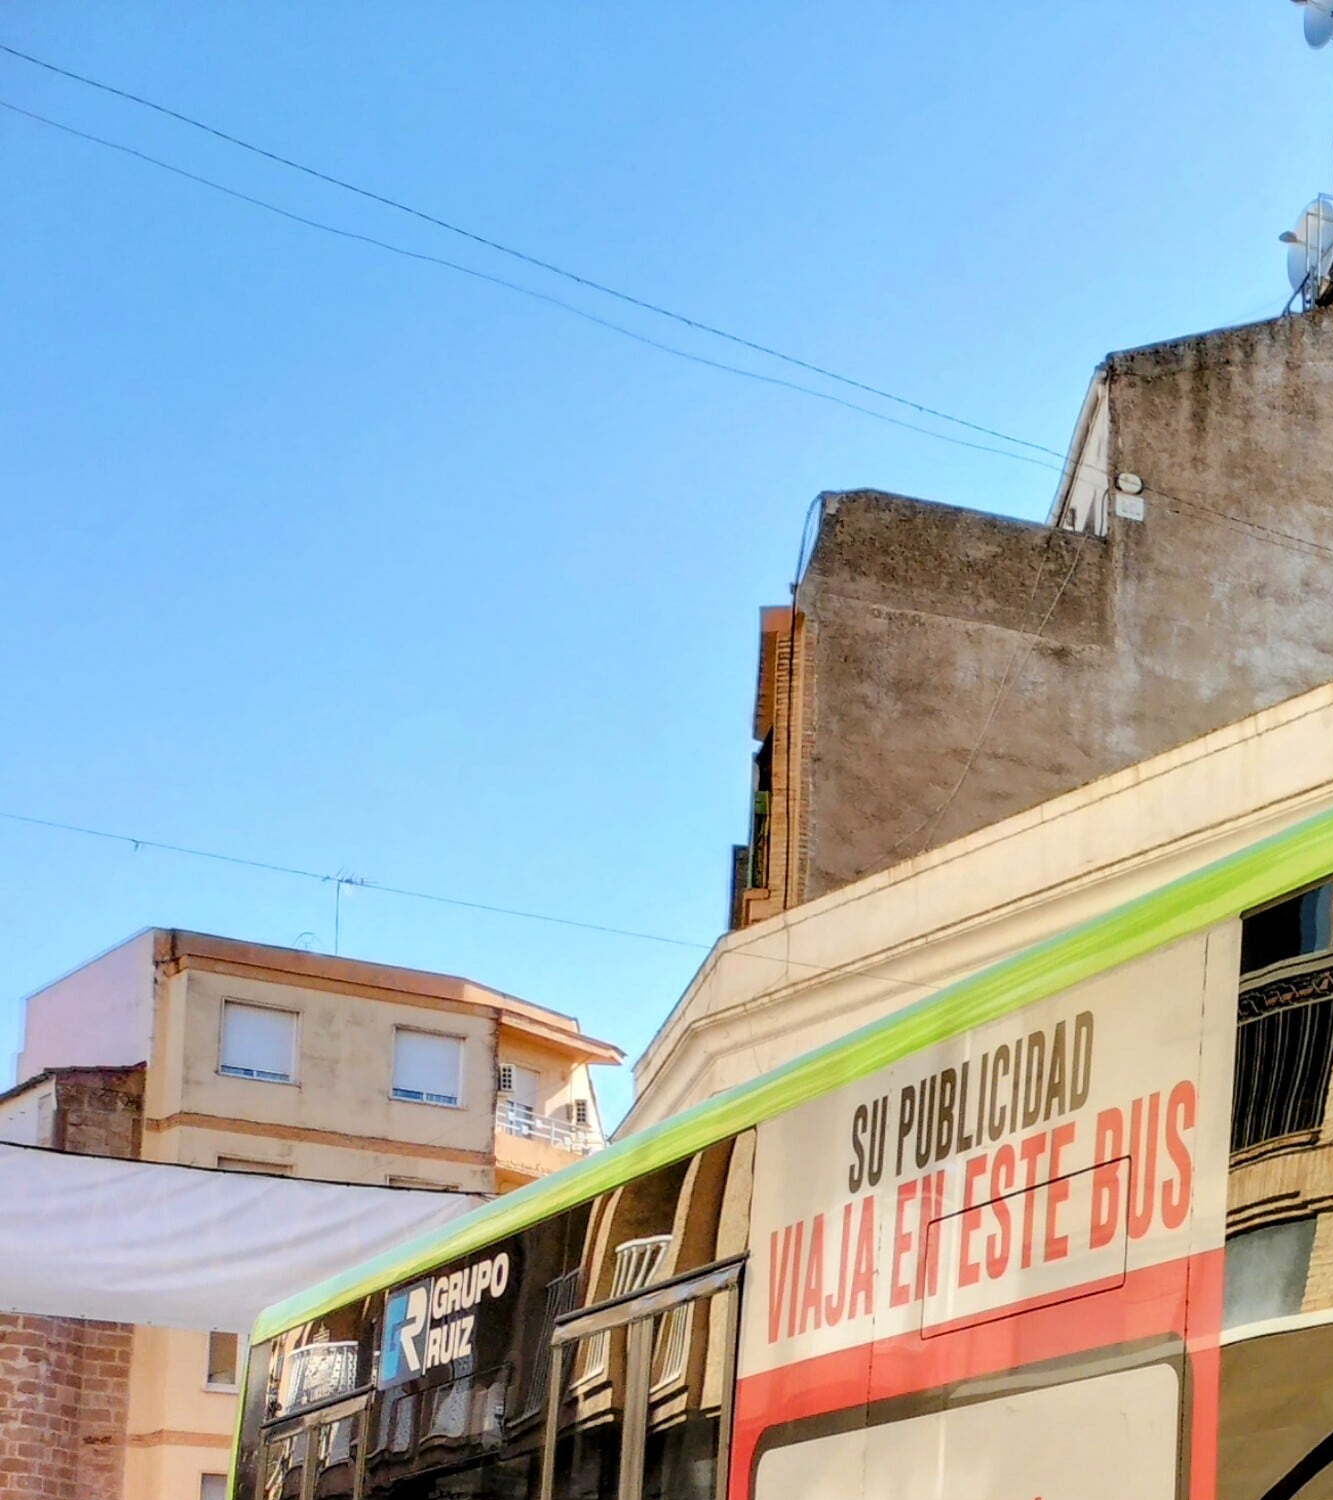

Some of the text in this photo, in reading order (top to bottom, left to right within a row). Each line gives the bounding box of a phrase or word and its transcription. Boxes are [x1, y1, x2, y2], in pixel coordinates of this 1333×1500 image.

[848, 1010, 1094, 1195] SU PUBLICIDAD
[767, 1079, 1196, 1344] VIAJA EN ESTE BUS
[426, 1314, 475, 1369] RUIZ
[432, 1252, 510, 1320] GRUPO
